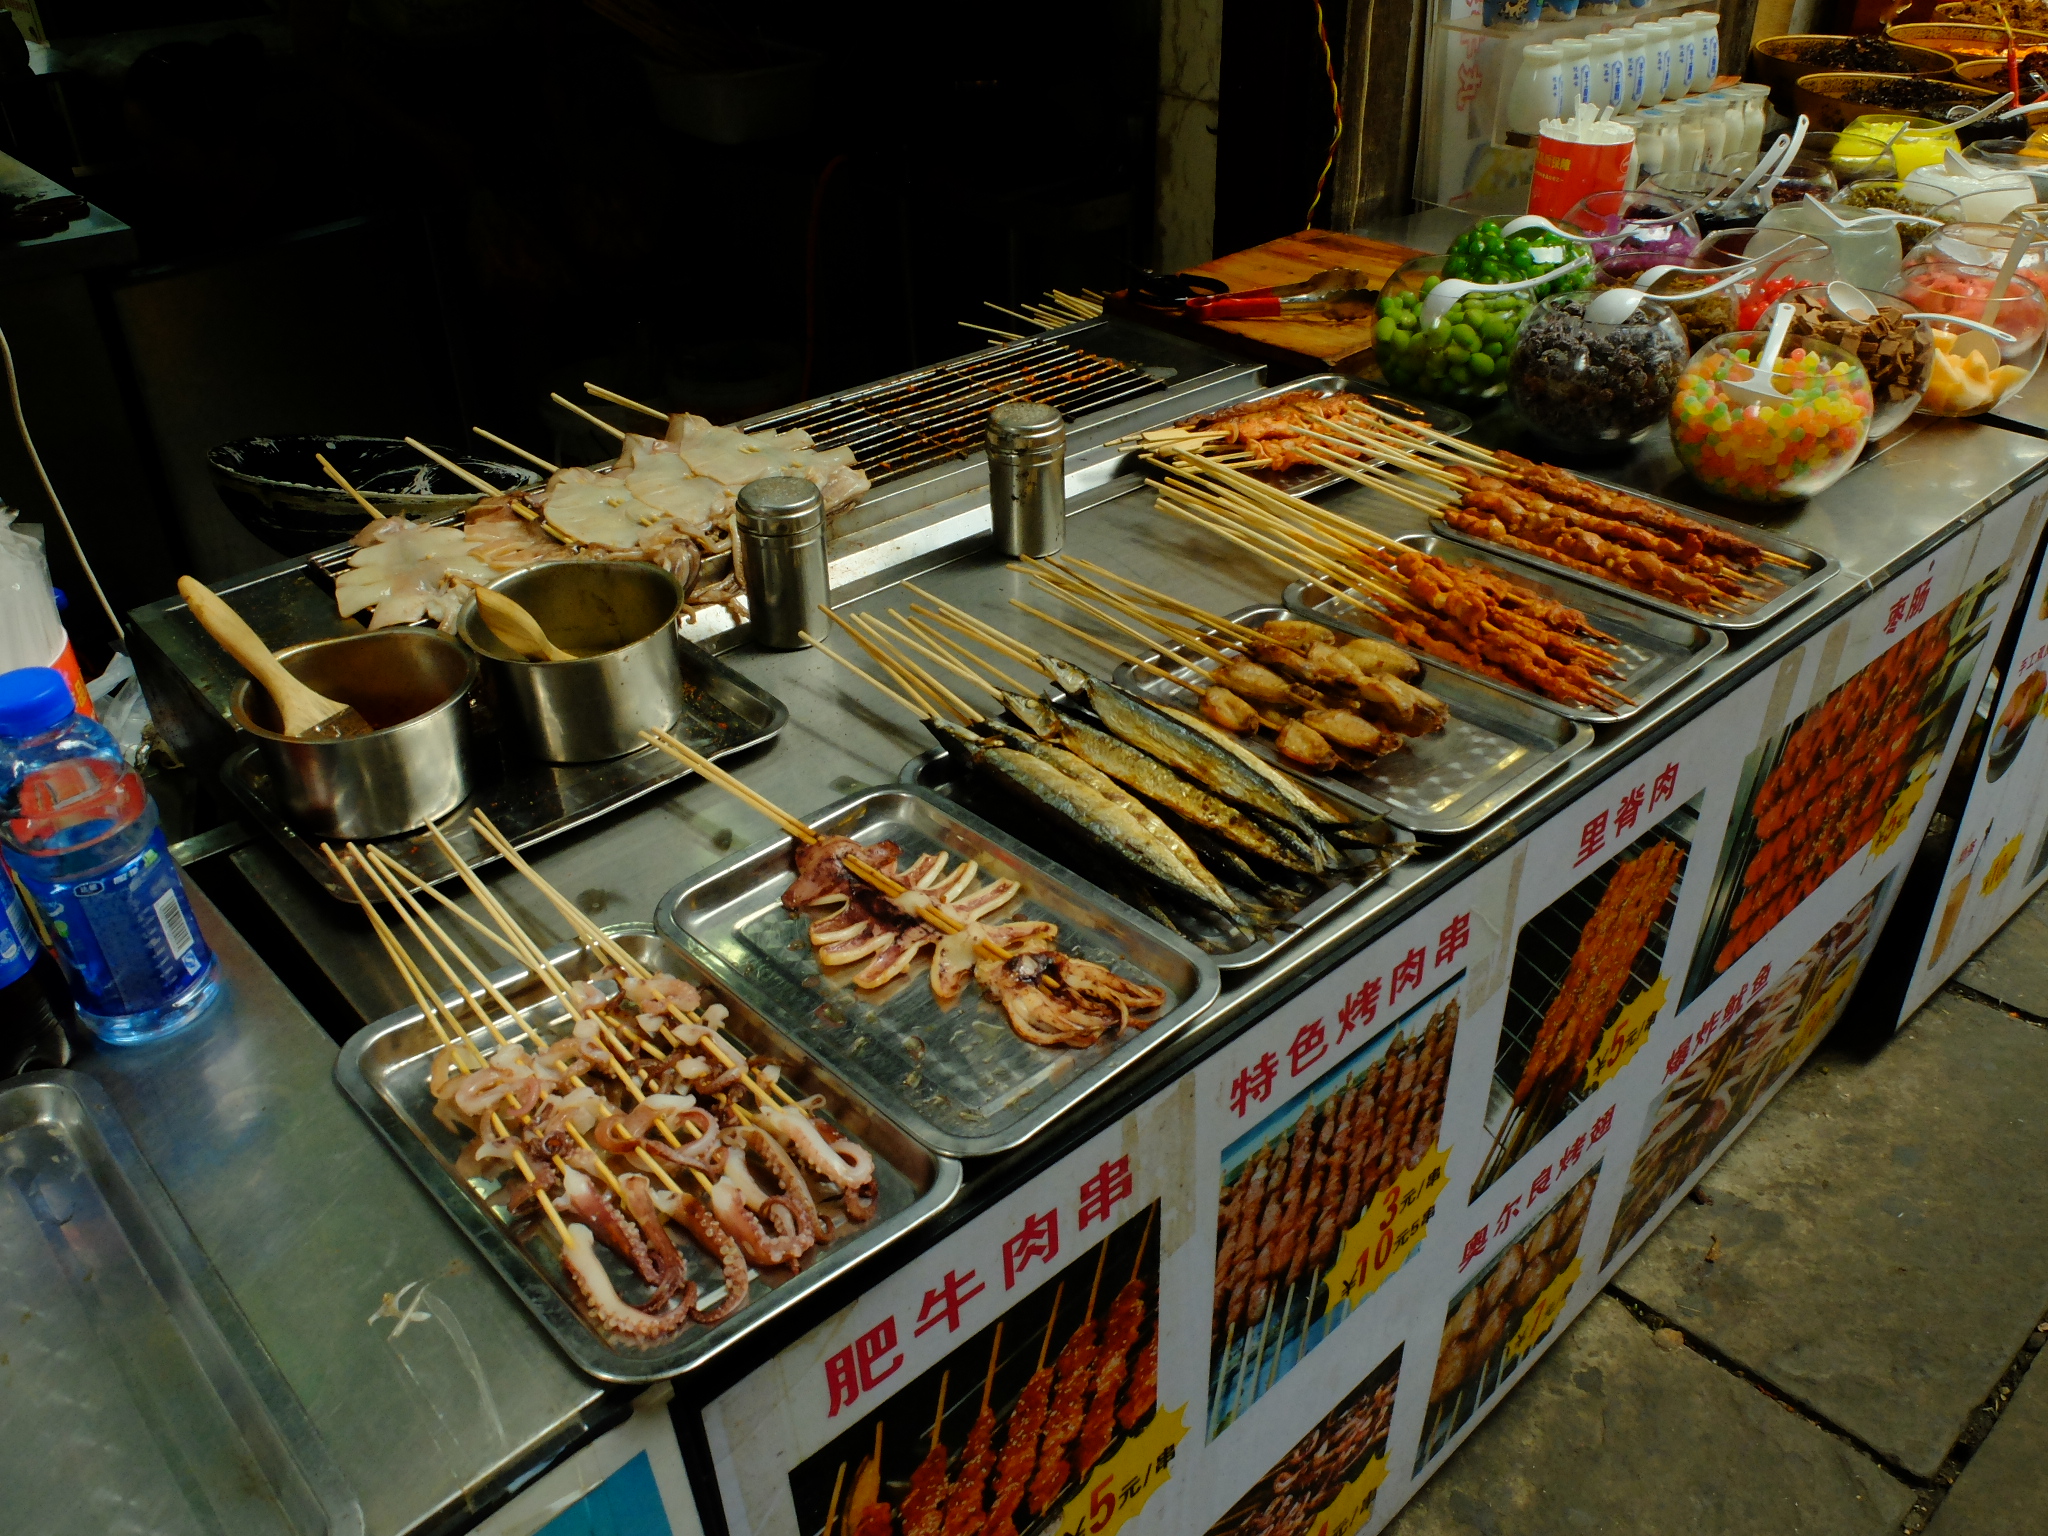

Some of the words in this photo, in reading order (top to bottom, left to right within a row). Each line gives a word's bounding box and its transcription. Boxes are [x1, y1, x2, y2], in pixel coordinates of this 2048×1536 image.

[1573, 762, 1679, 869] 里脊肉
[1230, 912, 1470, 1118] 特色烤肉串
[1662, 961, 1773, 1084] 爆炸鱿鱼
[1459, 1104, 1616, 1273] 奥尔良烤翅
[824, 1155, 1133, 1418] 肥牛肉串
